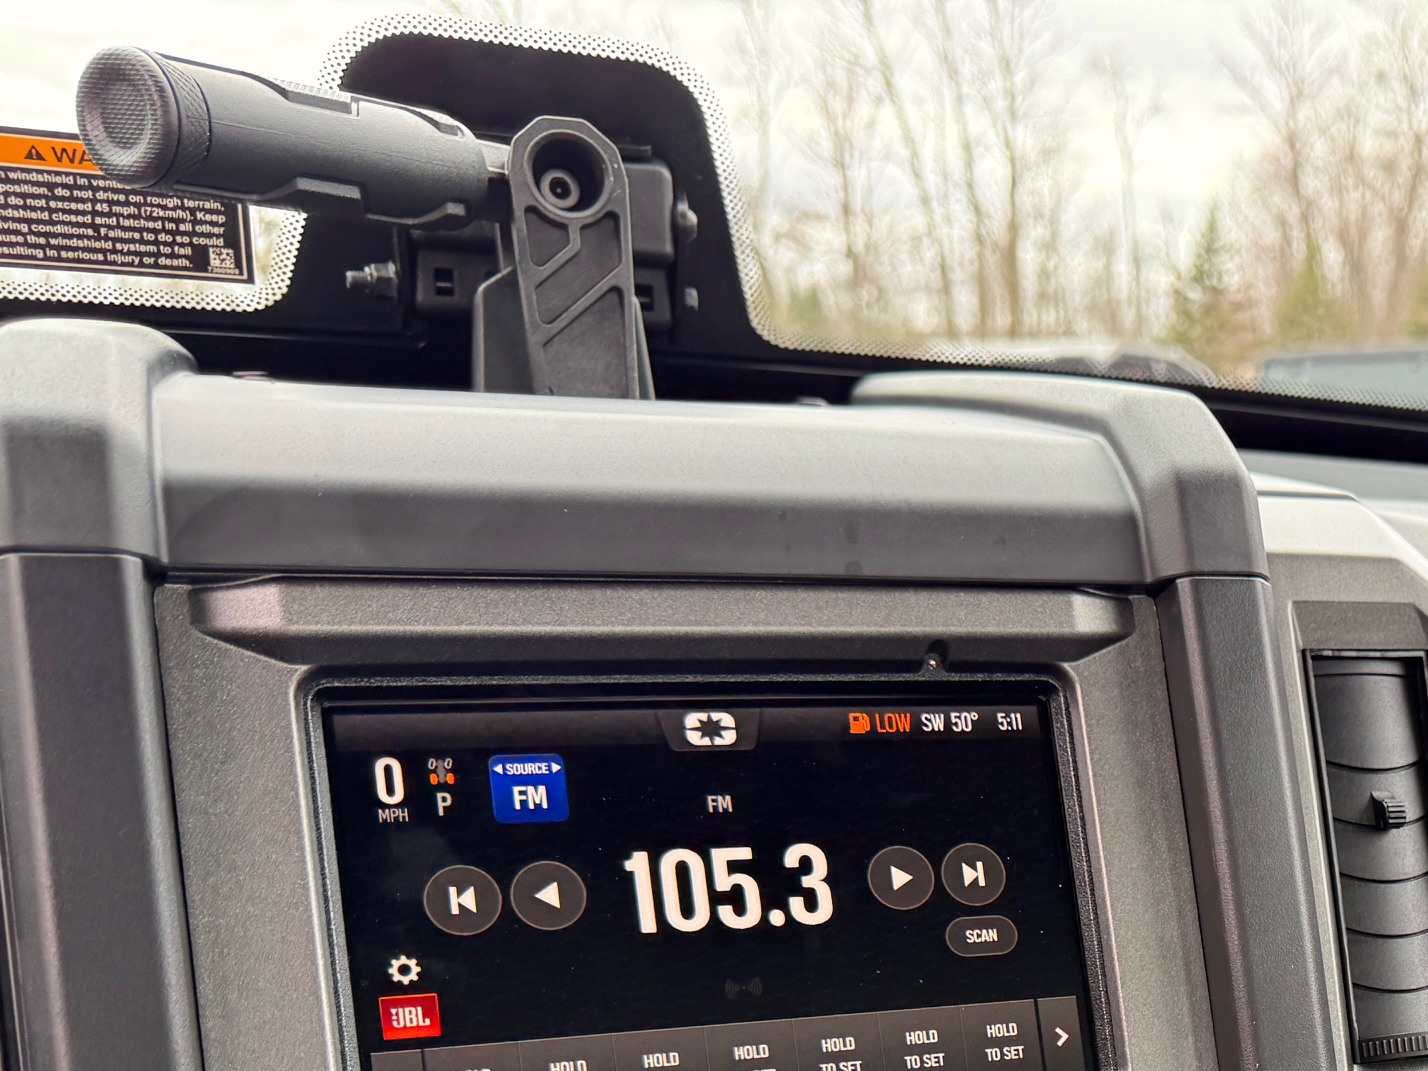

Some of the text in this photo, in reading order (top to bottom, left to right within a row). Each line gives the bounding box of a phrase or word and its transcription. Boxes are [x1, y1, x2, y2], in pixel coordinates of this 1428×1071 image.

[7, 170, 74, 185] windshield
[77, 176, 88, 186] in
[0, 183, 225, 211] position, do not drive on rough terrain,
[7, 195, 24, 205] do
[26, 198, 47, 208] not
[49, 200, 92, 211] exceed
[94, 202, 110, 212] 45
[112, 206, 138, 216] mph
[141, 206, 194, 221] (72km/h).
[196, 211, 226, 224] Keep
[52, 212, 92, 224] closed
[94, 216, 117, 226] and
[119, 217, 162, 230] latched
[165, 222, 176, 230] in
[179, 223, 192, 232] all
[195, 225, 225, 235] other
[31, 224, 98, 237] conditions.
[100, 227, 141, 239] Failure
[143, 232, 155, 241] to
[158, 233, 173, 242] do
[175, 235, 190, 244] so
[192, 237, 224, 247] could
[26, 235, 46, 245] the
[48, 237, 113, 250] windshield
[115, 242, 157, 253] system
[160, 245, 172, 254] to
[174, 245, 192, 256] fail
[46, 248, 58, 257] in
[60, 250, 104, 261] serious
[107, 252, 140, 266] injury
[143, 256, 156, 264] or
[158, 257, 193, 268] death.
[876, 711, 1023, 734] LOW SW 50° 5:11
[506, 761, 550, 777] SOURCE
[374, 756, 405, 805] 0
[436, 792, 453, 817] P
[512, 785, 549, 810] FM
[707, 795, 733, 813] FM
[378, 808, 409, 823] MPH
[624, 843, 834, 934] 105.3
[965, 928, 999, 944] SCAN
[390, 1006, 431, 1030] JBL
[905, 1029, 939, 1046] HOLD
[986, 1022, 1018, 1038] HOLD
[733, 1044, 769, 1061] HOLD
[821, 1036, 856, 1053] HOLD
[985, 1045, 1024, 1062] TO SET
[643, 1052, 680, 1069] HOLD
[904, 1053, 945, 1070] TO SET
